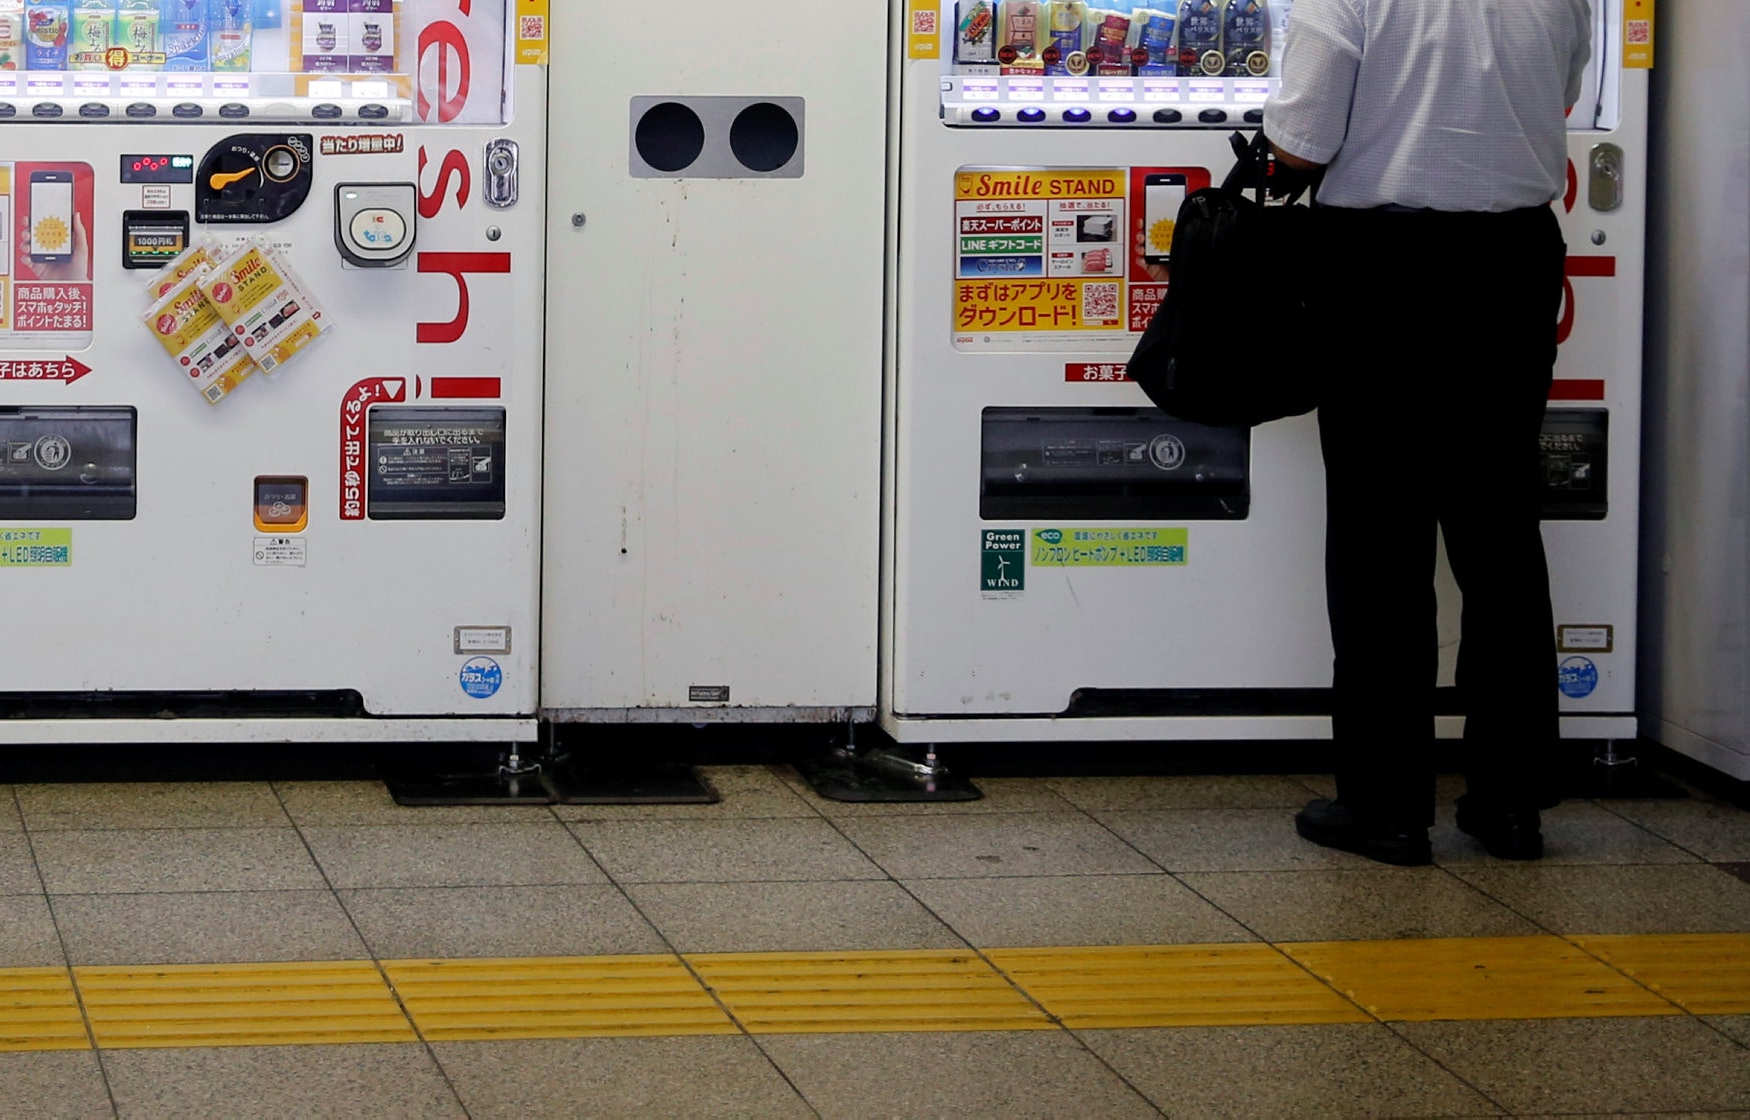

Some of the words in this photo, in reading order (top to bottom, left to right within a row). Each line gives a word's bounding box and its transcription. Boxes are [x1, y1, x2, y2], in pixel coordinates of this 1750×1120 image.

[321, 134, 402, 154] 当たり増量中!
[976, 174, 1042, 196] Smile
[1049, 179, 1115, 195] STAND
[976, 202, 1026, 212] 必ず、もらえる!
[1059, 201, 1111, 211] 抽選で、当たる!
[961, 218, 1042, 232] 楽天スーパーポイント
[961, 239, 986, 251] LINE
[987, 239, 1042, 251] ギフトコード
[230, 257, 262, 285] Smile
[237, 266, 268, 292] STAND
[17, 286, 88, 301] 商品購入後、
[959, 281, 1077, 302] まずはアプリを
[17, 301, 87, 314] スマホをタッチ!
[17, 315, 87, 328] ポイントたまる!
[959, 306, 1077, 327] ダウンロード!
[987, 531, 1020, 542] Green
[1041, 530, 1061, 541] eco
[1074, 530, 1159, 541] 環境にやさしく省エネです
[986, 540, 1021, 551] Power
[987, 578, 1020, 588] WIND
